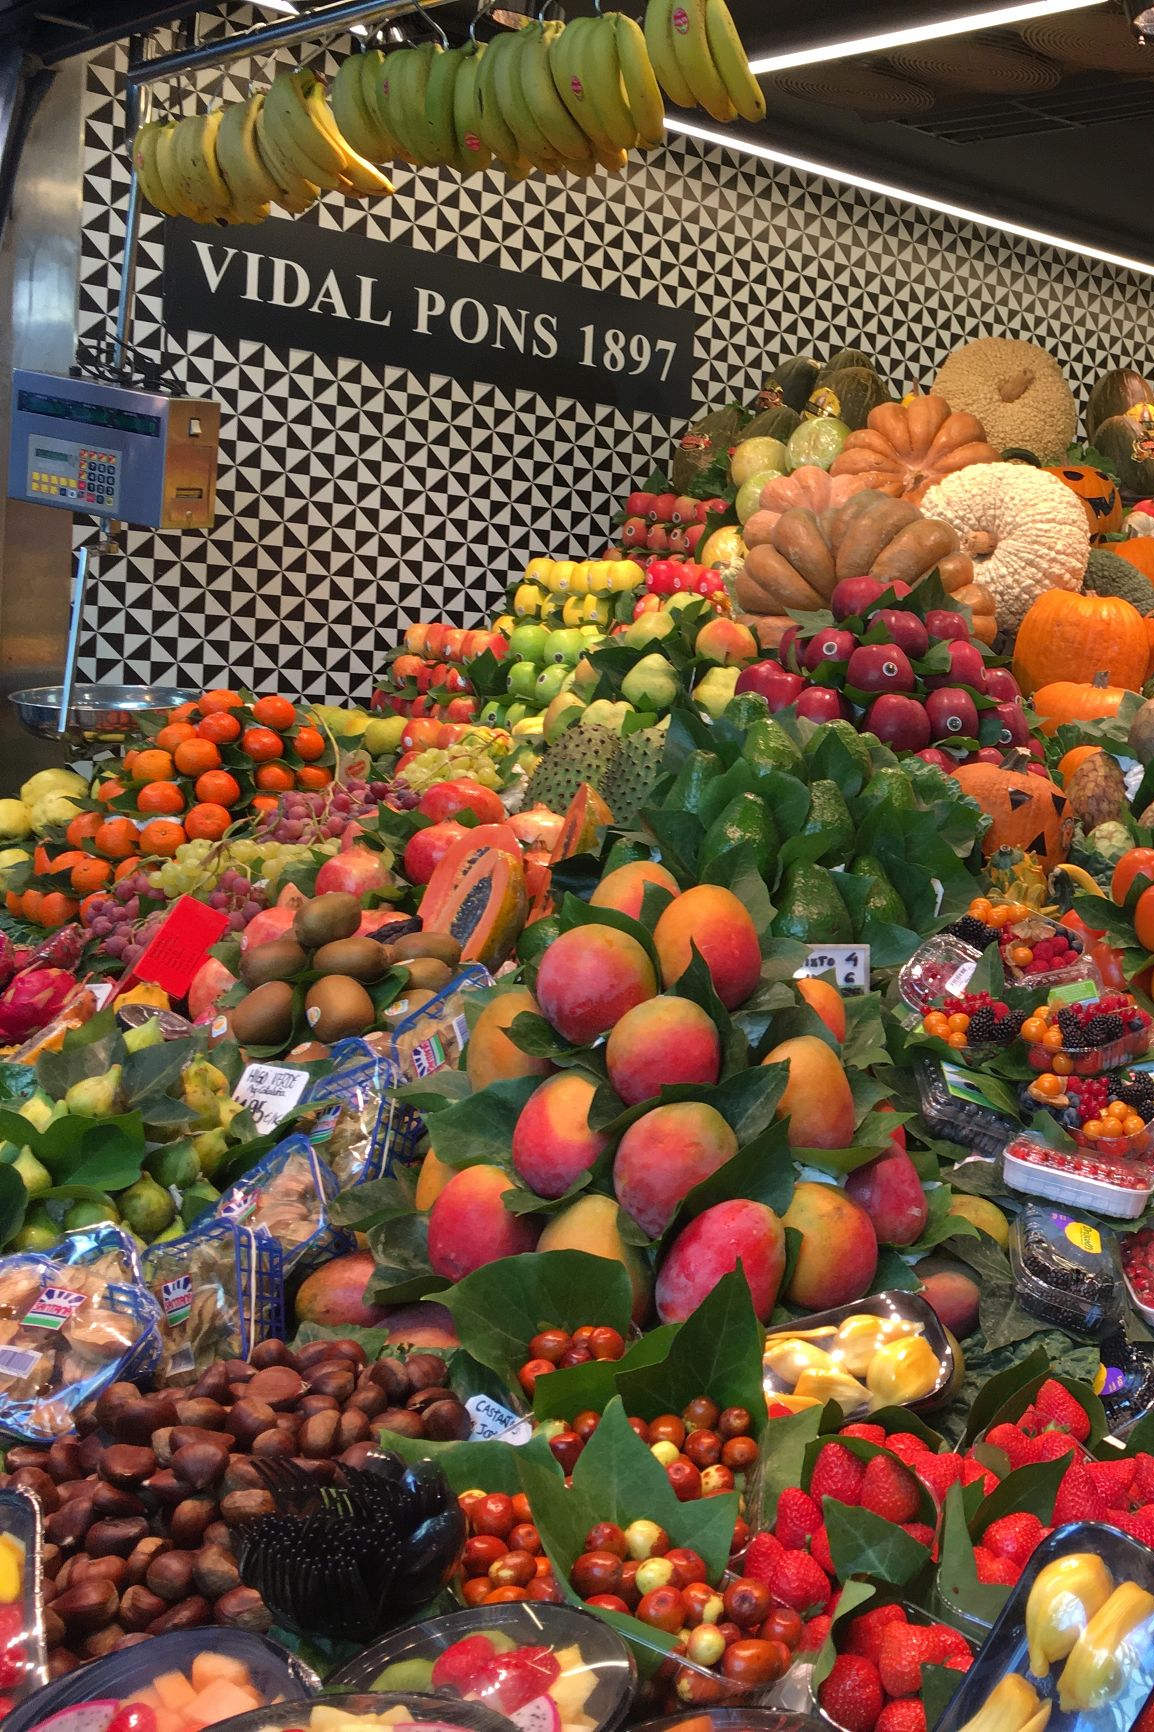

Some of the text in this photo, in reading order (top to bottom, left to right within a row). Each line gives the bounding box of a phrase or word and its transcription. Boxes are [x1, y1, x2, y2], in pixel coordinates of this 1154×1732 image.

[192, 240, 677, 382] VIDAL PONS 1897
[844, 951, 859, 968] 4
